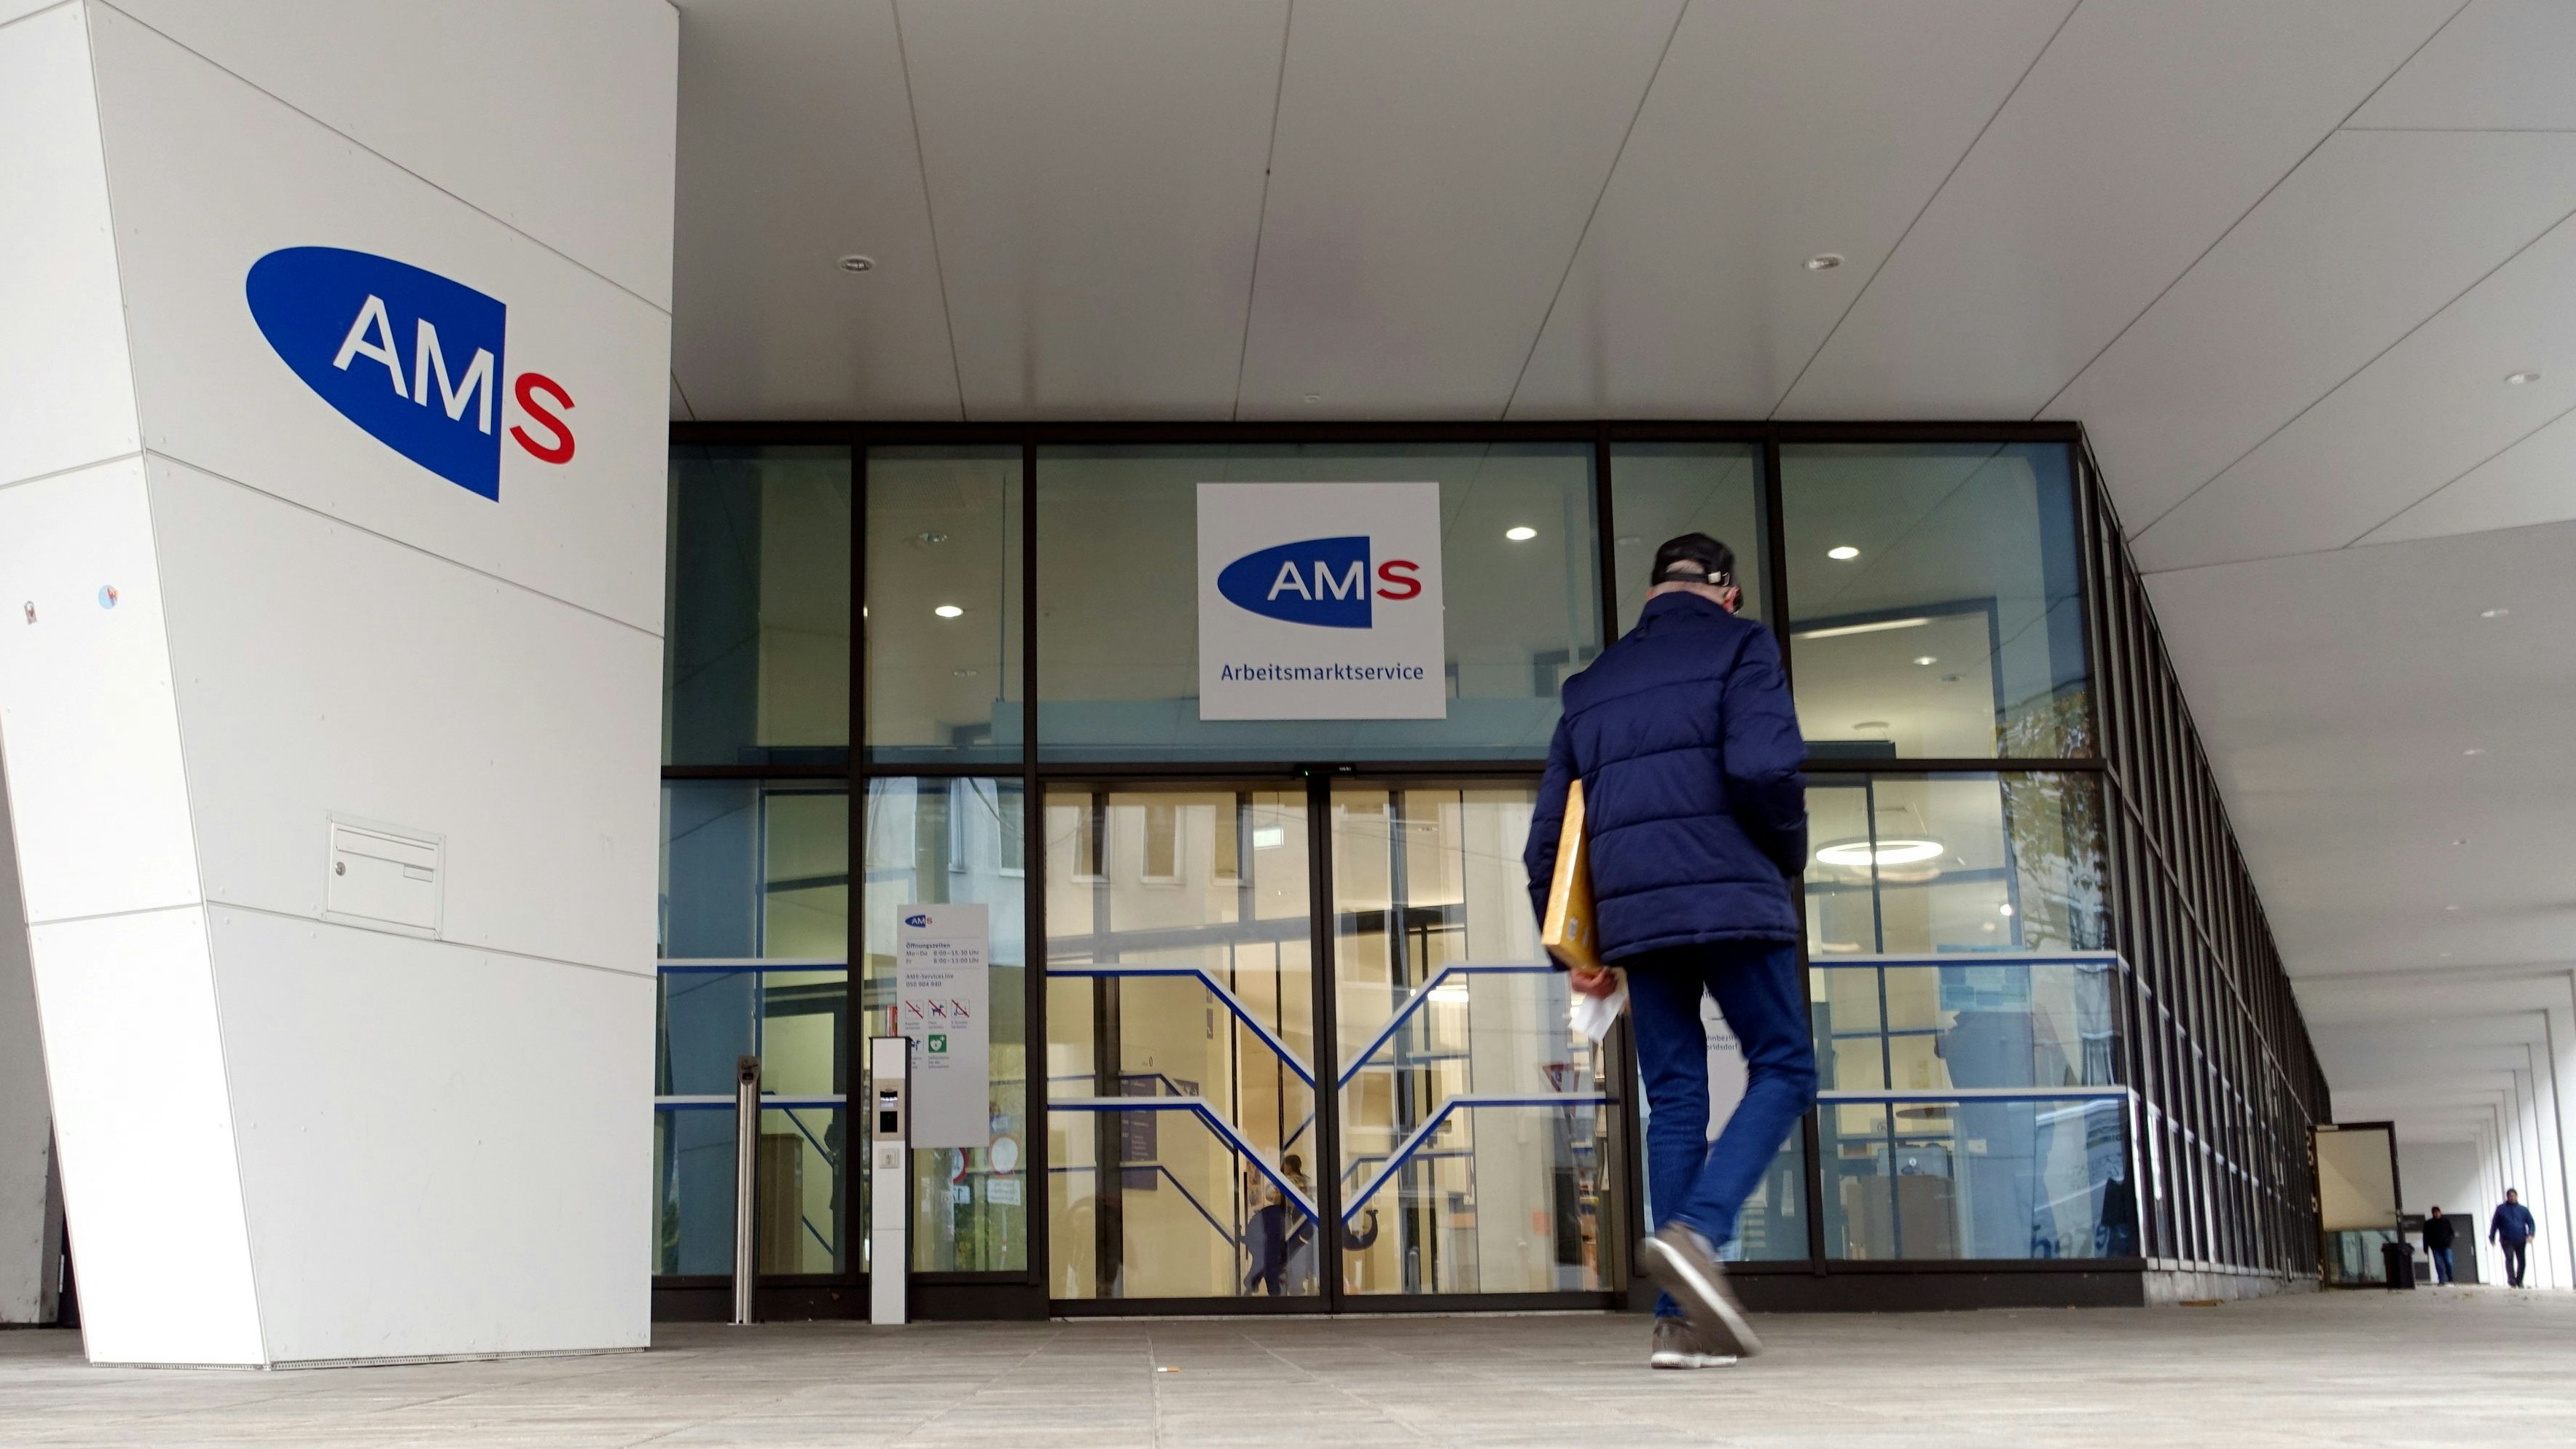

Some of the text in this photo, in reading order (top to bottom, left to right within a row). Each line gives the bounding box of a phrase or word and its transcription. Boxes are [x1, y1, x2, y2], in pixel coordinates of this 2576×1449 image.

[332, 294, 576, 465] AMS
[1267, 560, 1422, 601] AMS
[1221, 663, 1424, 681] Arbeitsmarktservice
[911, 917, 933, 925] AMS
